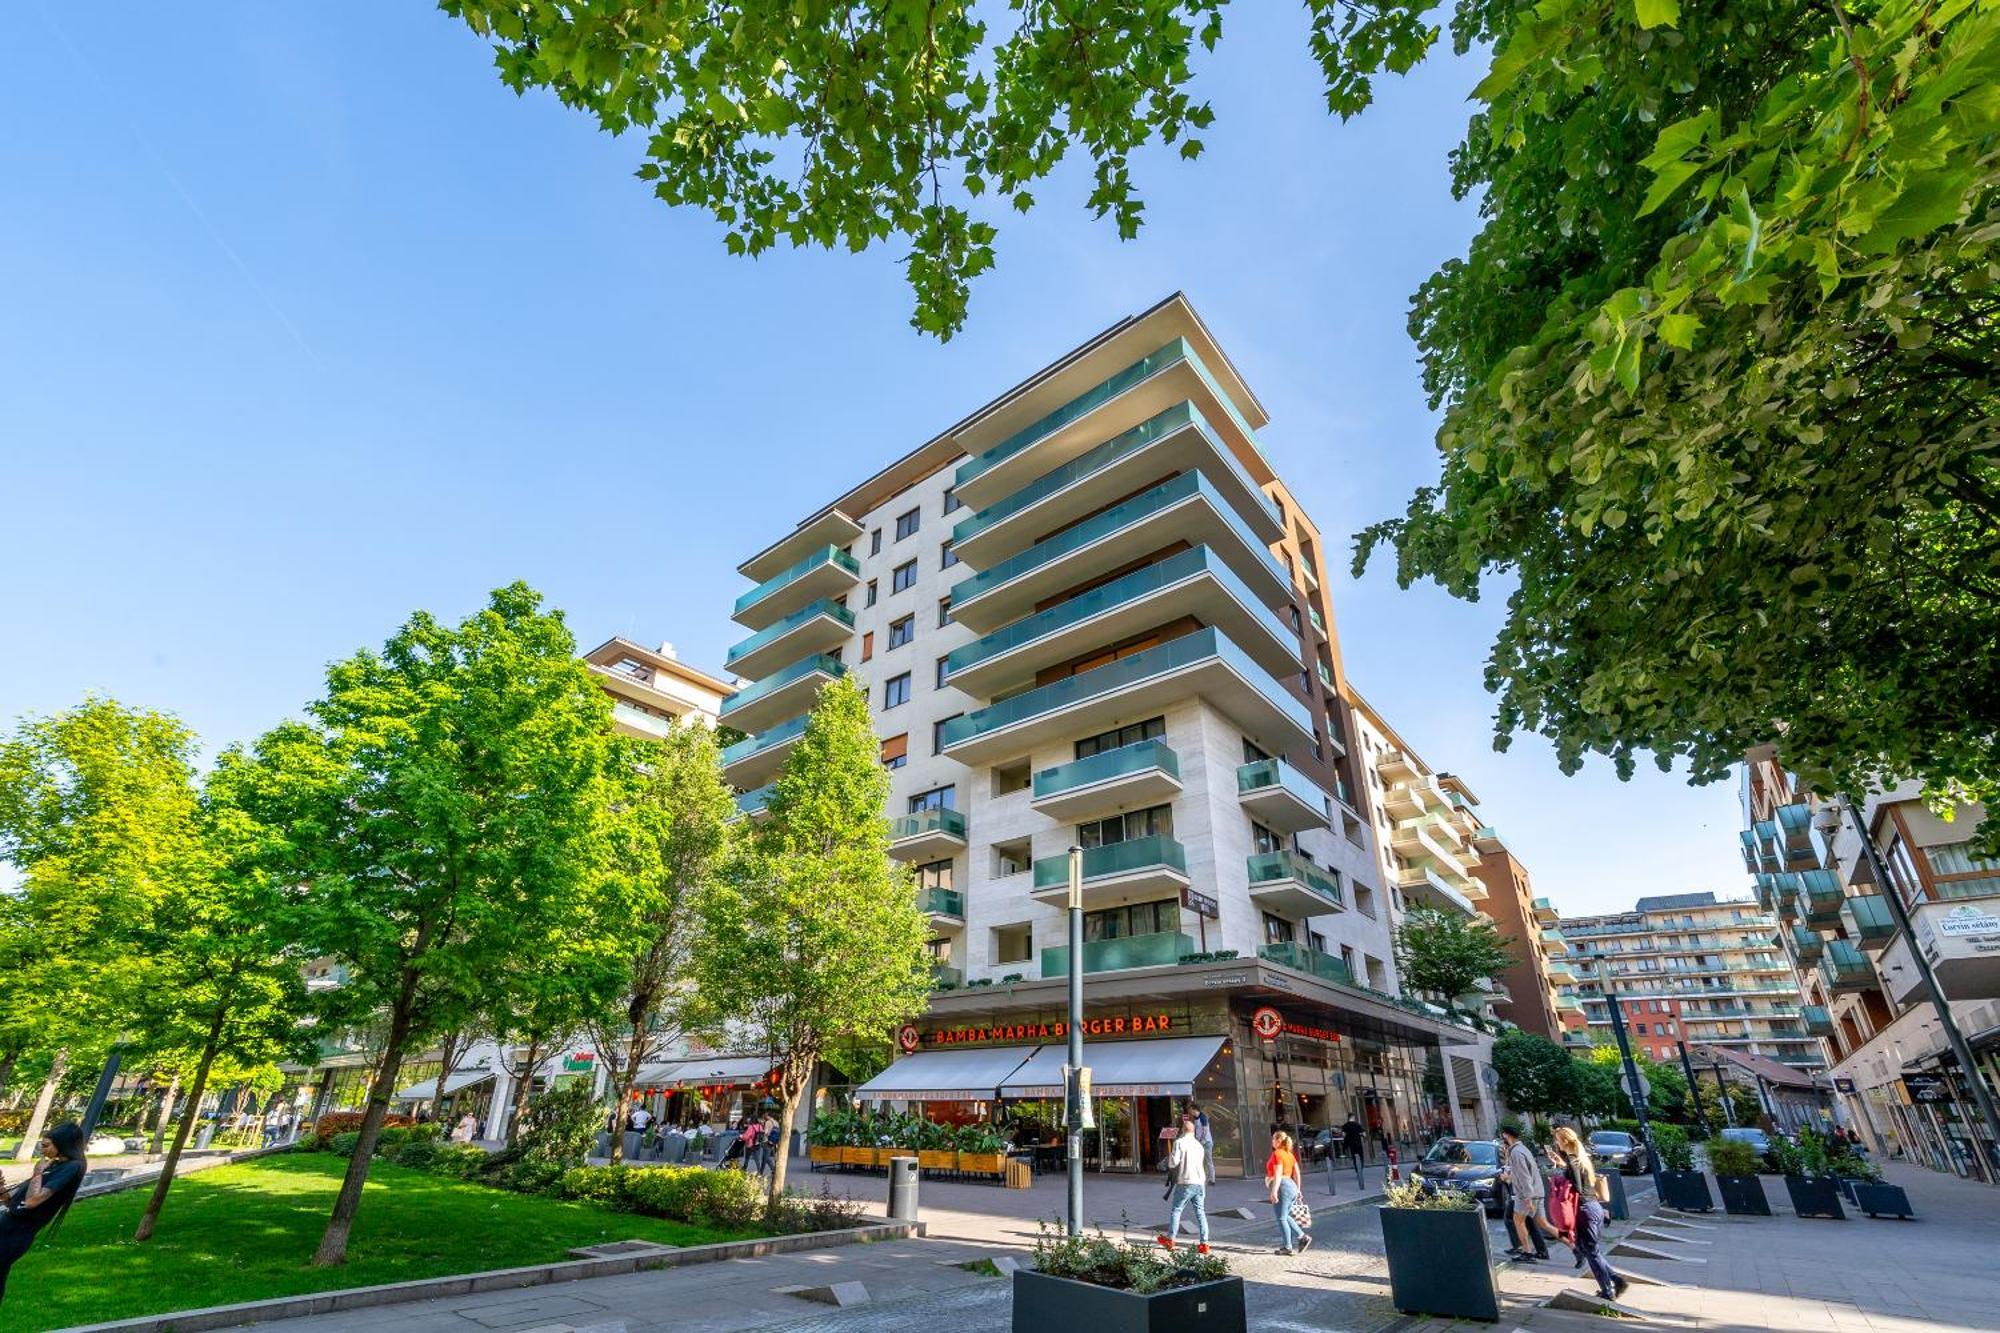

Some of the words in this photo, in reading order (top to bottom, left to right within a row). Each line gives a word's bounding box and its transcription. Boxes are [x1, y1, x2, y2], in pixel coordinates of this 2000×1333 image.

[936, 1027, 986, 1044] BAMBA
[991, 1023, 1048, 1041] MARHA
[1055, 1018, 1125, 1036] BRGER
[1132, 1015, 1169, 1031] BAR
